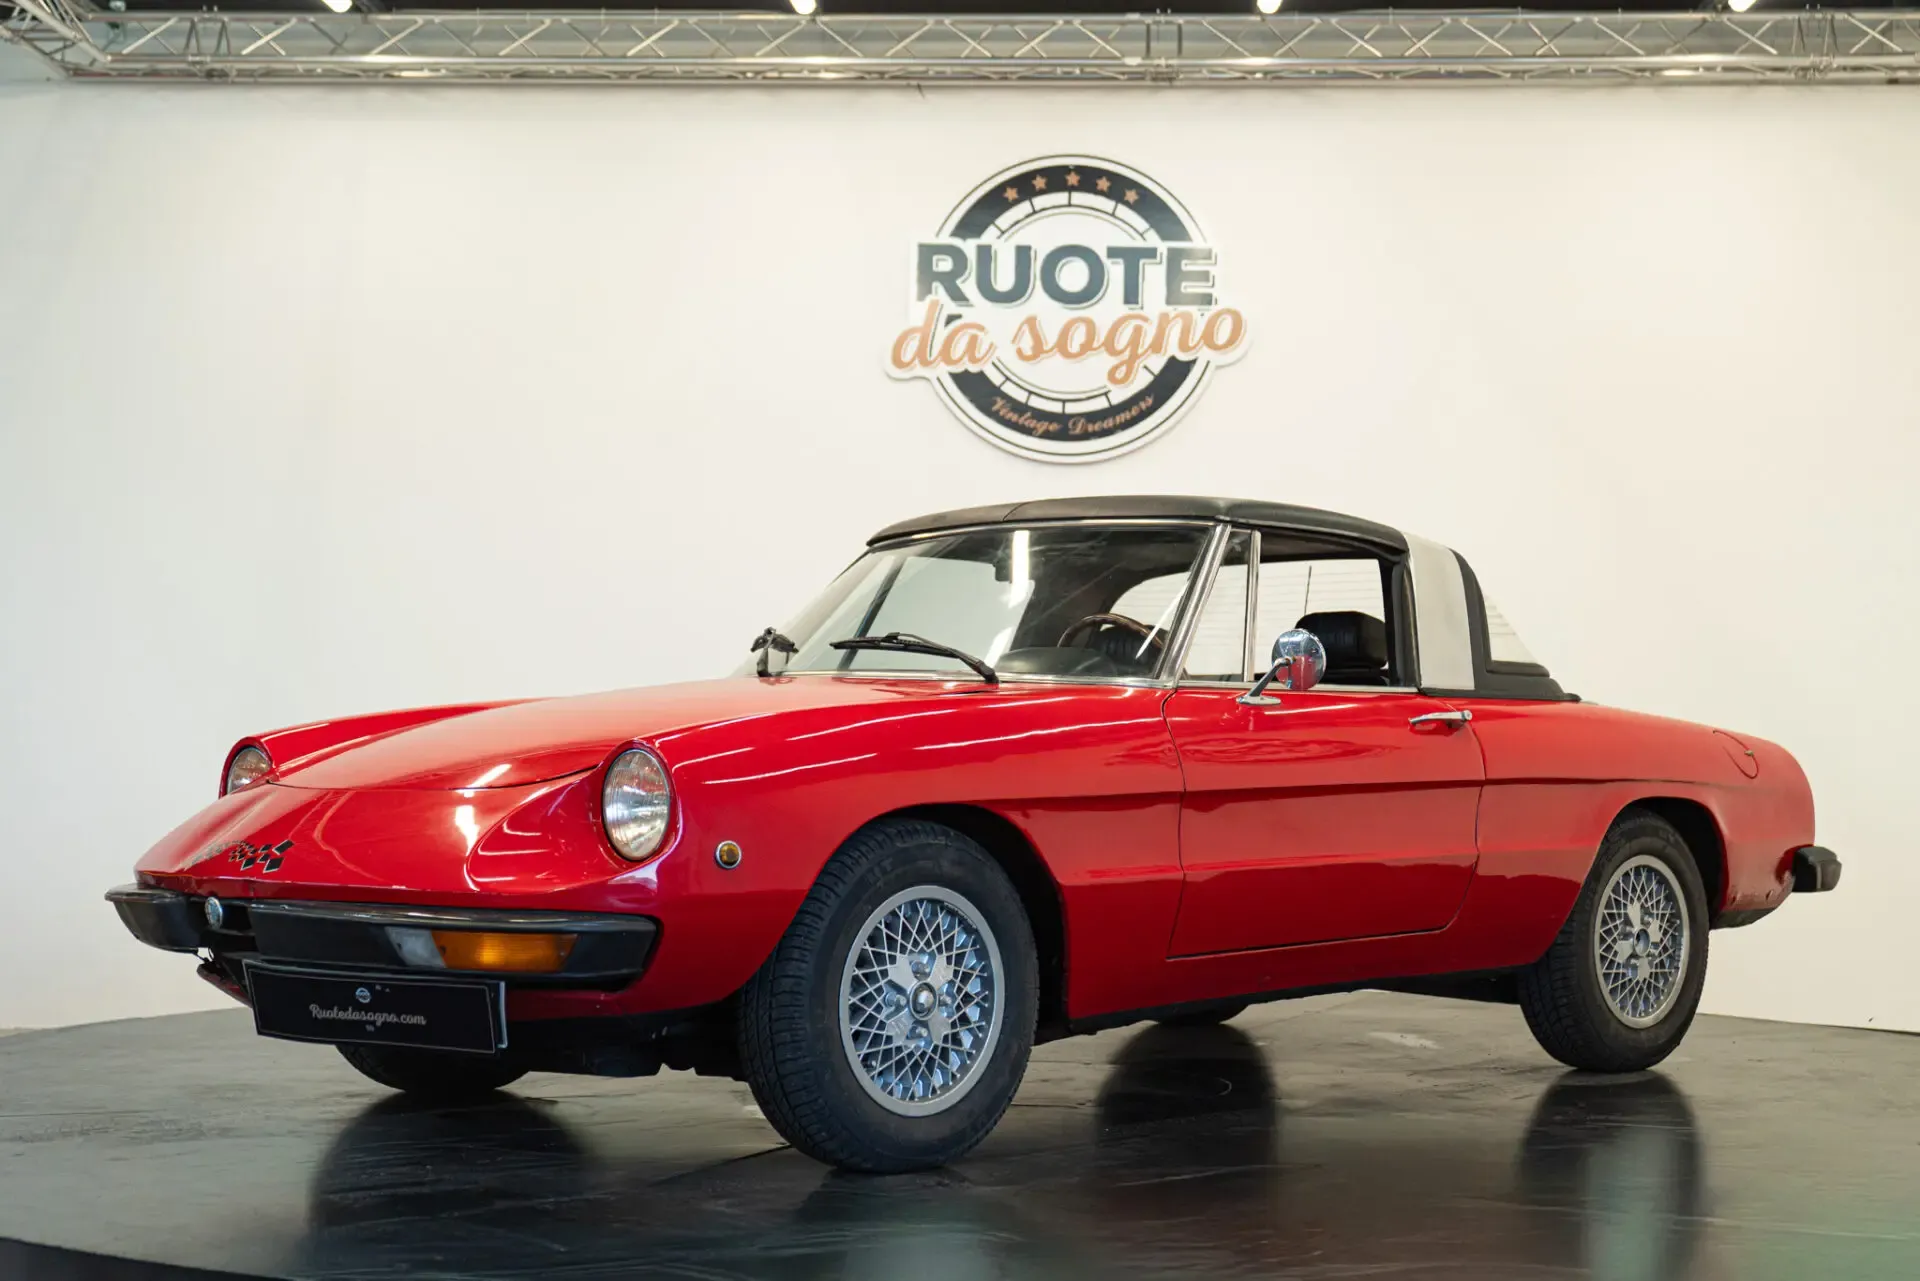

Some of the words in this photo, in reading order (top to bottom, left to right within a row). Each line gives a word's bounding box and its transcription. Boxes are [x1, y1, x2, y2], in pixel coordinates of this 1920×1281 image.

[916, 243, 1215, 307] RUOTE
[891, 299, 994, 369] da
[1014, 308, 1244, 385] sogno
[991, 396, 1063, 436] Vintage
[1068, 393, 1154, 435] Dreamers
[309, 1004, 426, 1026] Ruotedasogno.com
